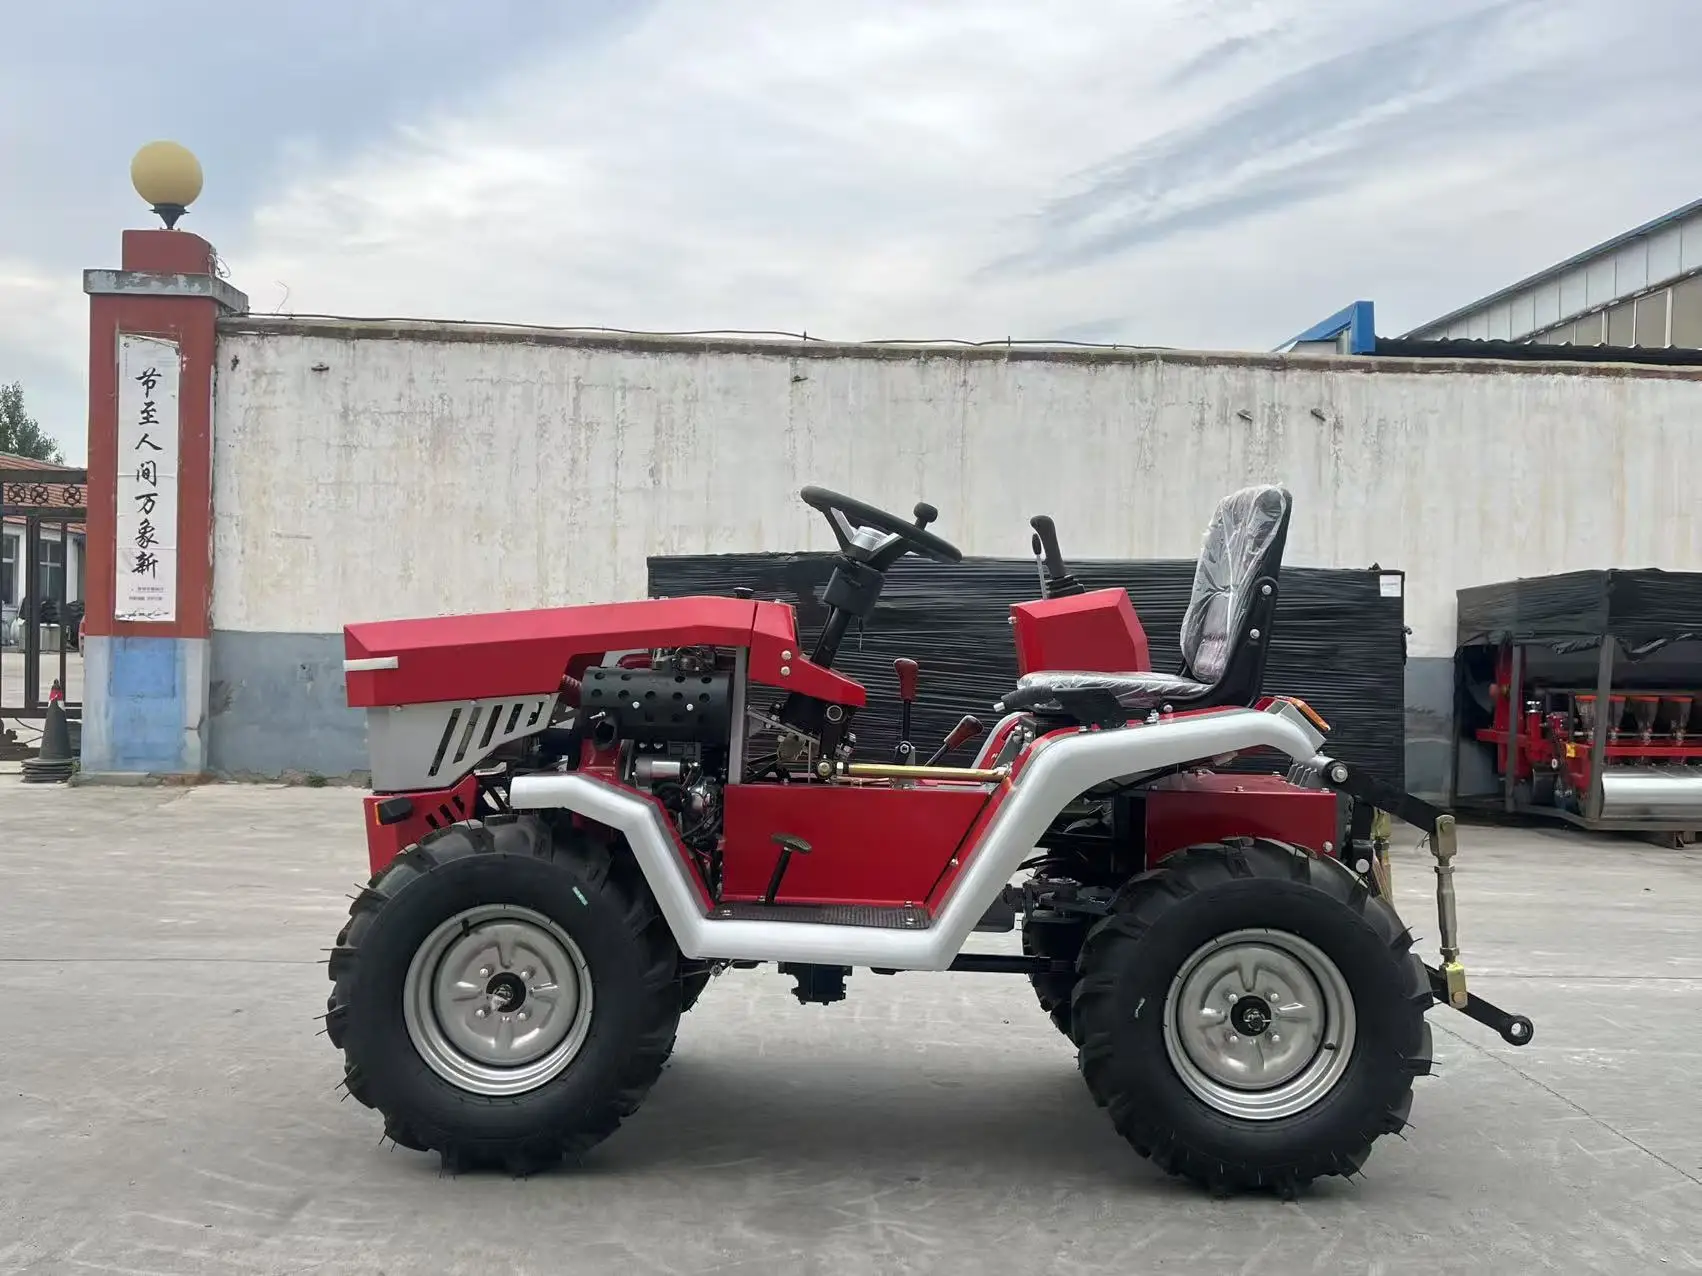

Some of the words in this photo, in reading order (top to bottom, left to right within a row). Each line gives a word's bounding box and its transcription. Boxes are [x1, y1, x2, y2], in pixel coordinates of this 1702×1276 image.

[131, 367, 162, 579] 节至人间万象新
